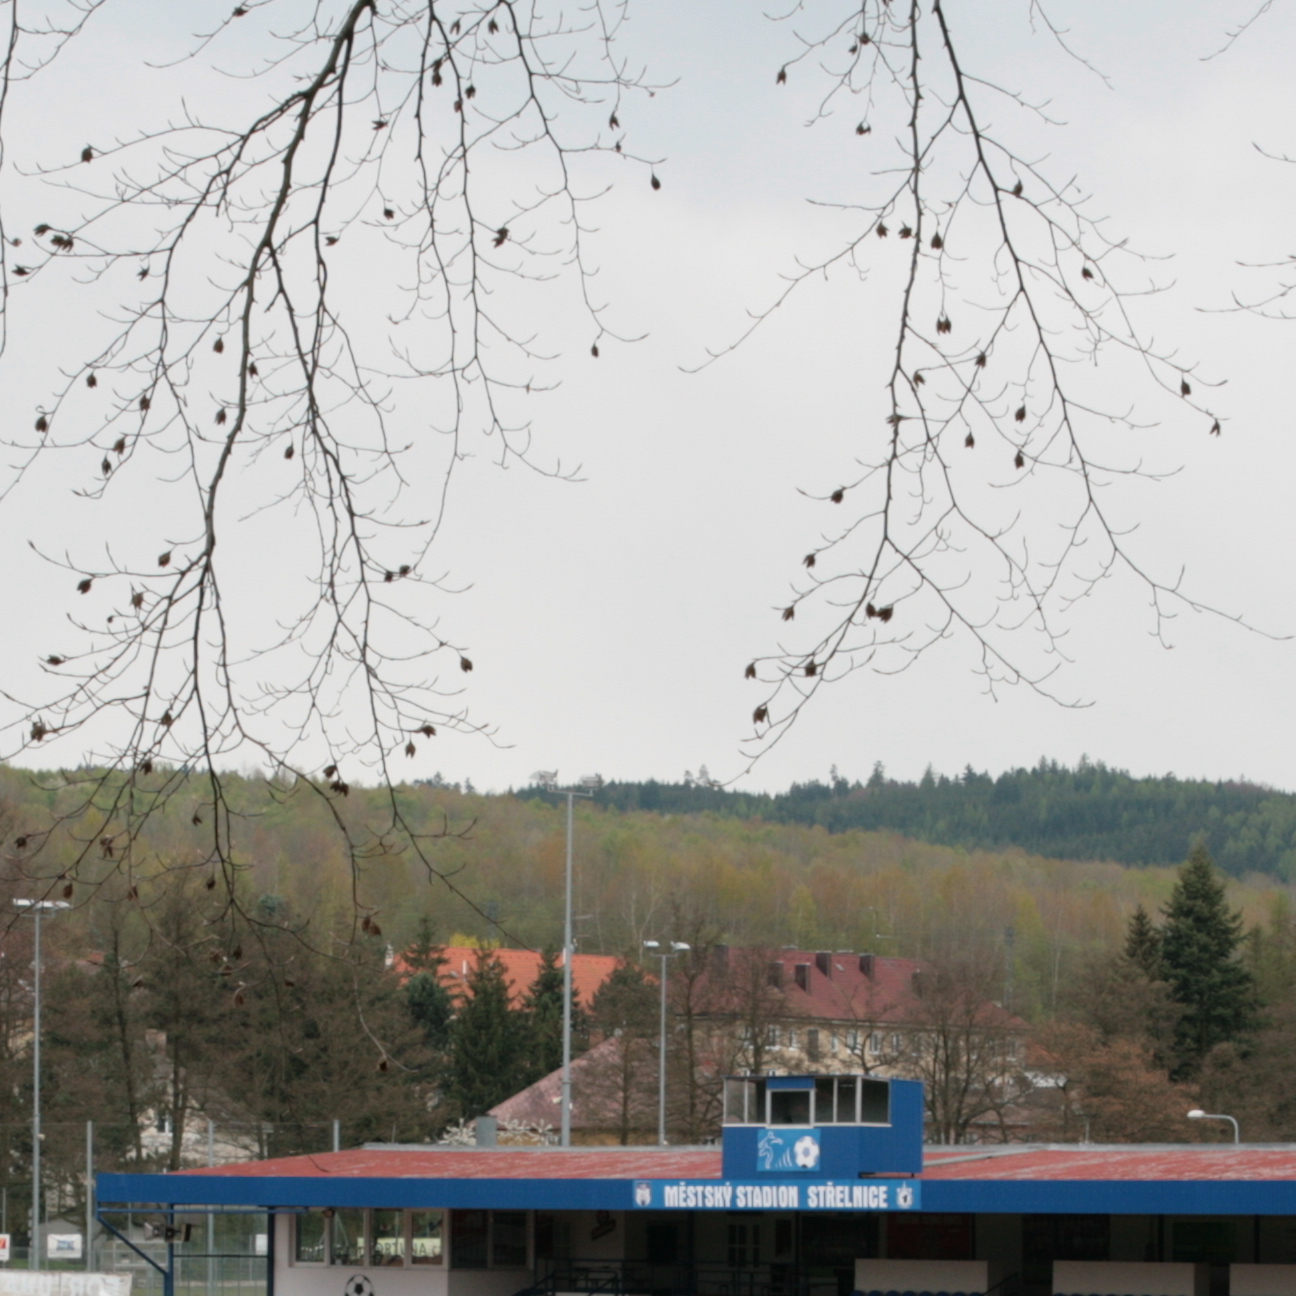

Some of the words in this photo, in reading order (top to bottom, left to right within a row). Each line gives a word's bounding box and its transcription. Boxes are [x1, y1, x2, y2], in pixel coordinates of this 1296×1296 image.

[664, 1181, 733, 1208] MĚSTSKÝ
[735, 1185, 799, 1208] STADION
[807, 1181, 889, 1208] STŘELNICE
